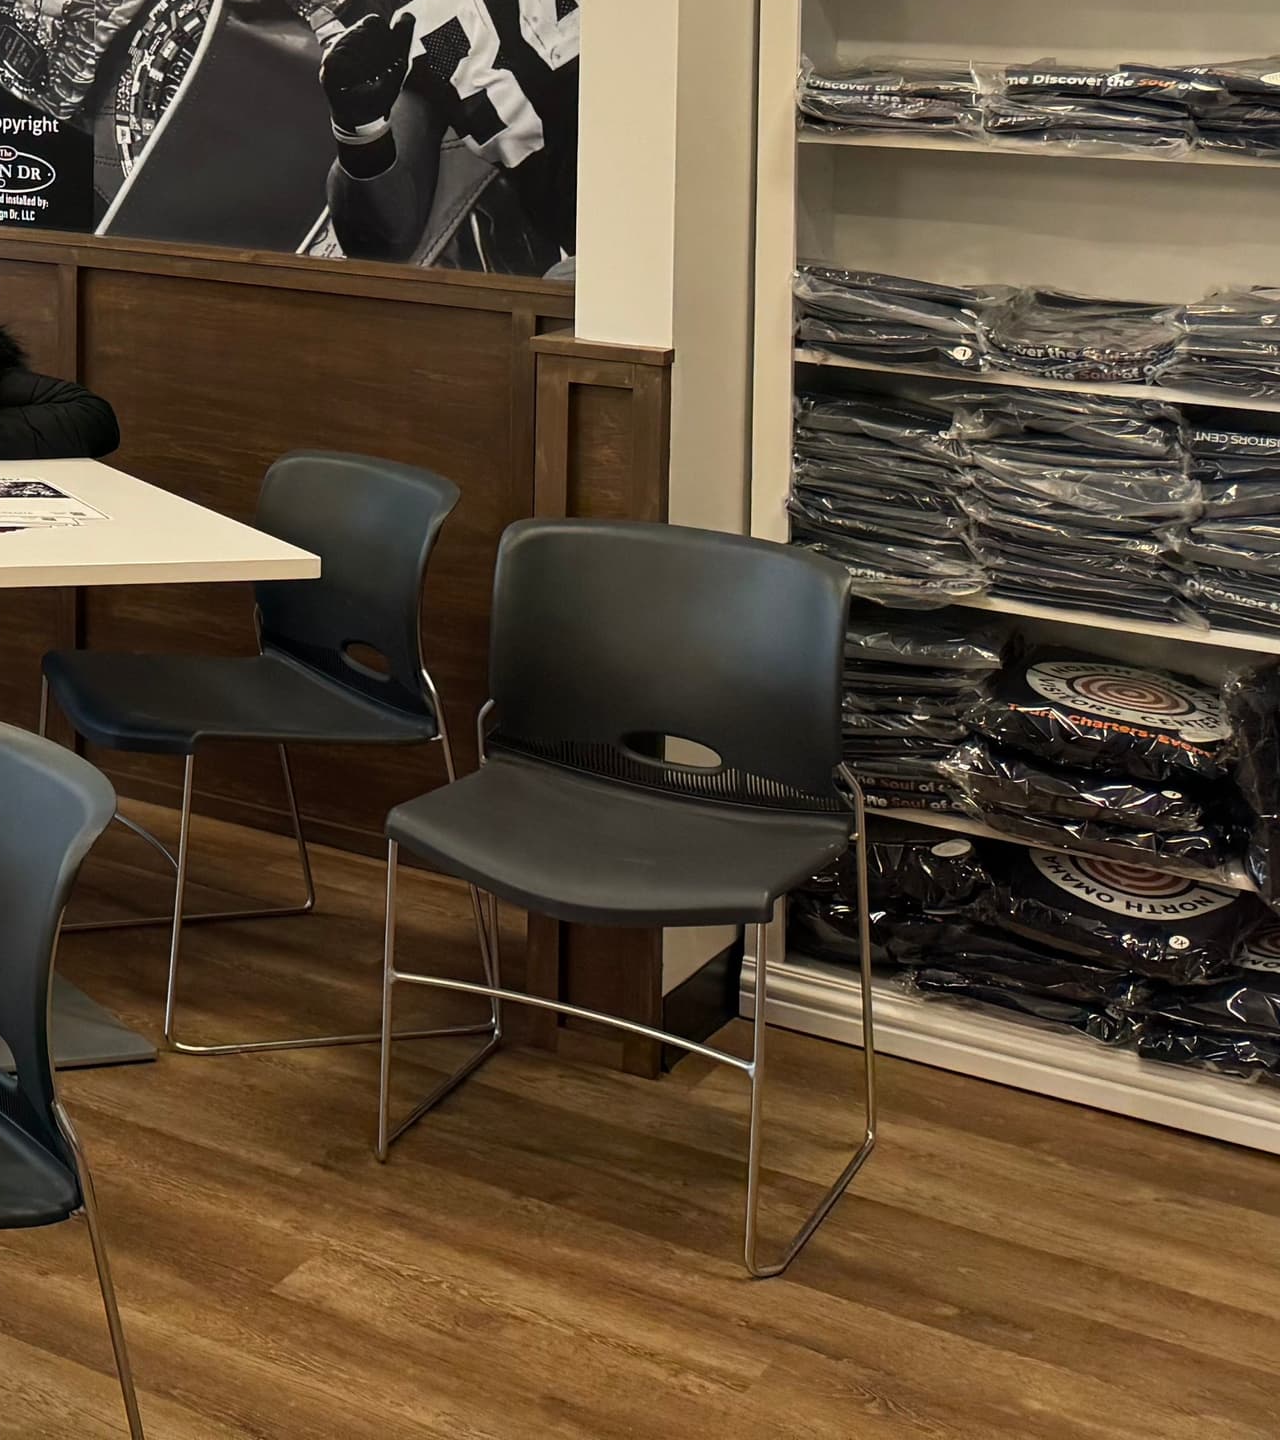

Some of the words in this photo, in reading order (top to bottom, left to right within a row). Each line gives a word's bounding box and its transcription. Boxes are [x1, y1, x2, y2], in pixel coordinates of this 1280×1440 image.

[1032, 74, 1103, 87] Discover
[1106, 72, 1135, 87] the
[0, 148, 13, 158] The
[16, 164, 42, 181] DR
[5, 193, 37, 207] installed
[21, 210, 36, 222] LLC
[1037, 676, 1122, 717] VISITORS
[1008, 702, 1056, 720] Turs
[1140, 715, 1222, 730] CENTER
[1042, 854, 1115, 904] OMAHA
[1125, 895, 1217, 916] NORTH
